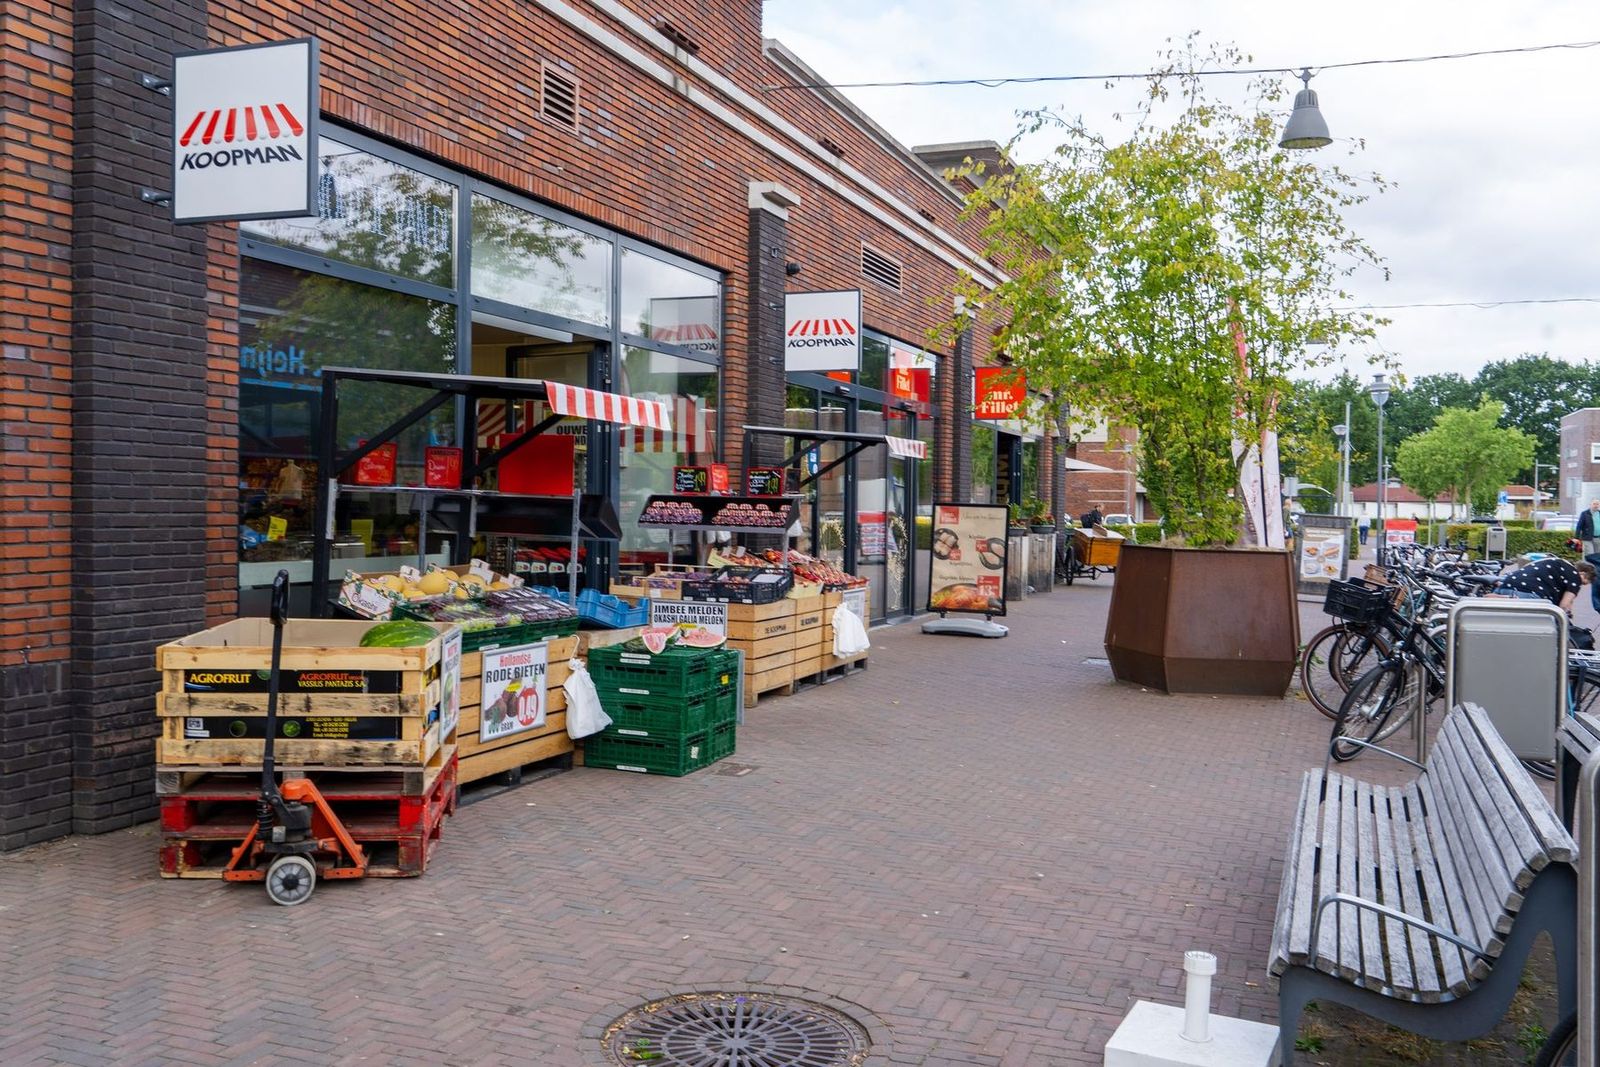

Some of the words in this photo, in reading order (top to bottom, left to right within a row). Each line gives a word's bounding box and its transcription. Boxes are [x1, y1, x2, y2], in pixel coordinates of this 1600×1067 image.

[180, 145, 303, 170] KOOPMAN
[787, 337, 855, 348] KOOPMAN
[654, 605, 687, 614] JIMBEE
[688, 605, 724, 616] MELOEN
[653, 614, 678, 623] OKASHI
[679, 614, 698, 624] GALIA
[699, 615, 724, 625] MELOEN
[190, 673, 252, 684] AGROFRUT
[299, 673, 349, 681] AGROFRUT
[485, 667, 512, 684] RODE
[514, 663, 546, 679] BIETEN
